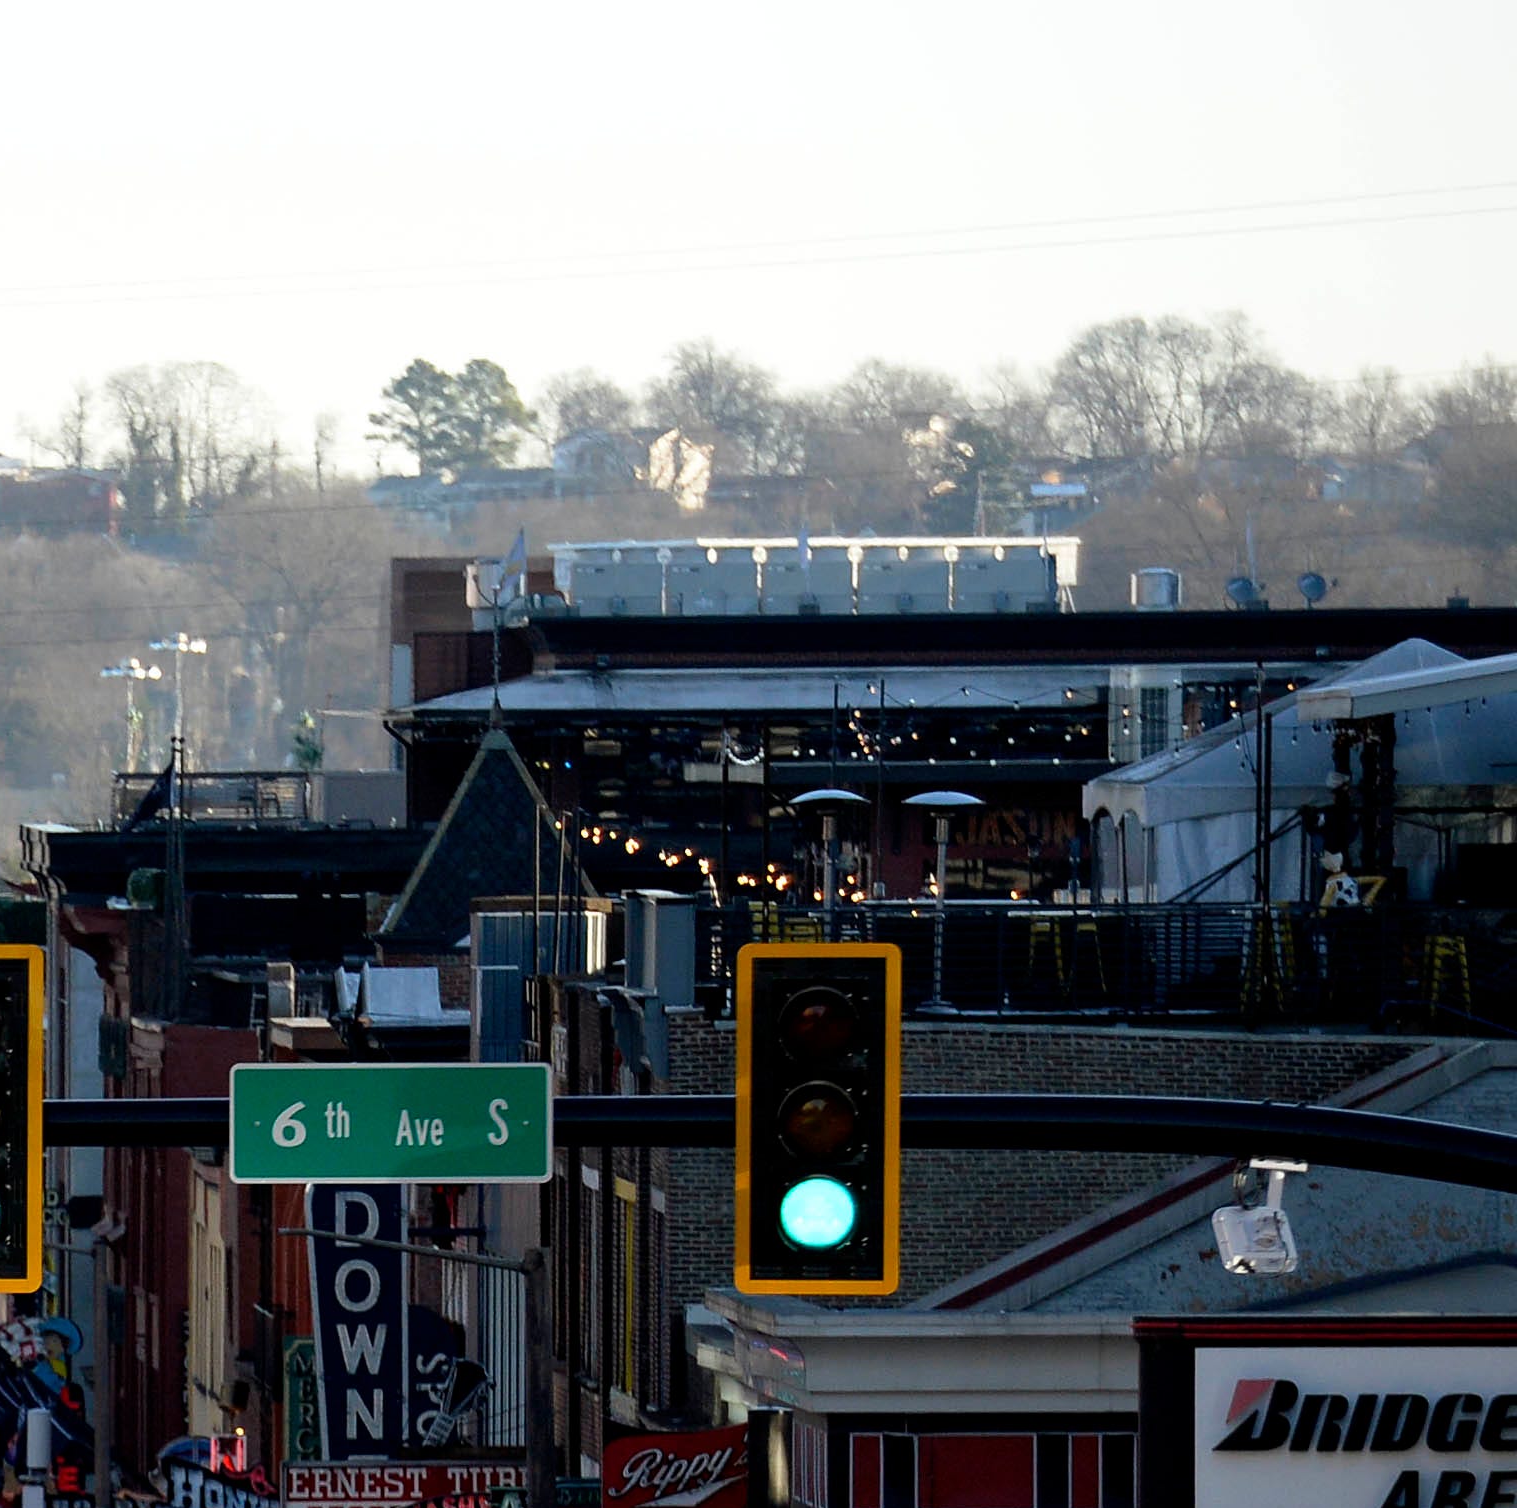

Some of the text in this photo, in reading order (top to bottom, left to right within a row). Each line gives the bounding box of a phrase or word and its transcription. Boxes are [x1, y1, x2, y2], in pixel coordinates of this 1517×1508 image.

[395, 1109, 445, 1146] Ave
[488, 1099, 509, 1145] S
[288, 1467, 428, 1499] ERNEST
